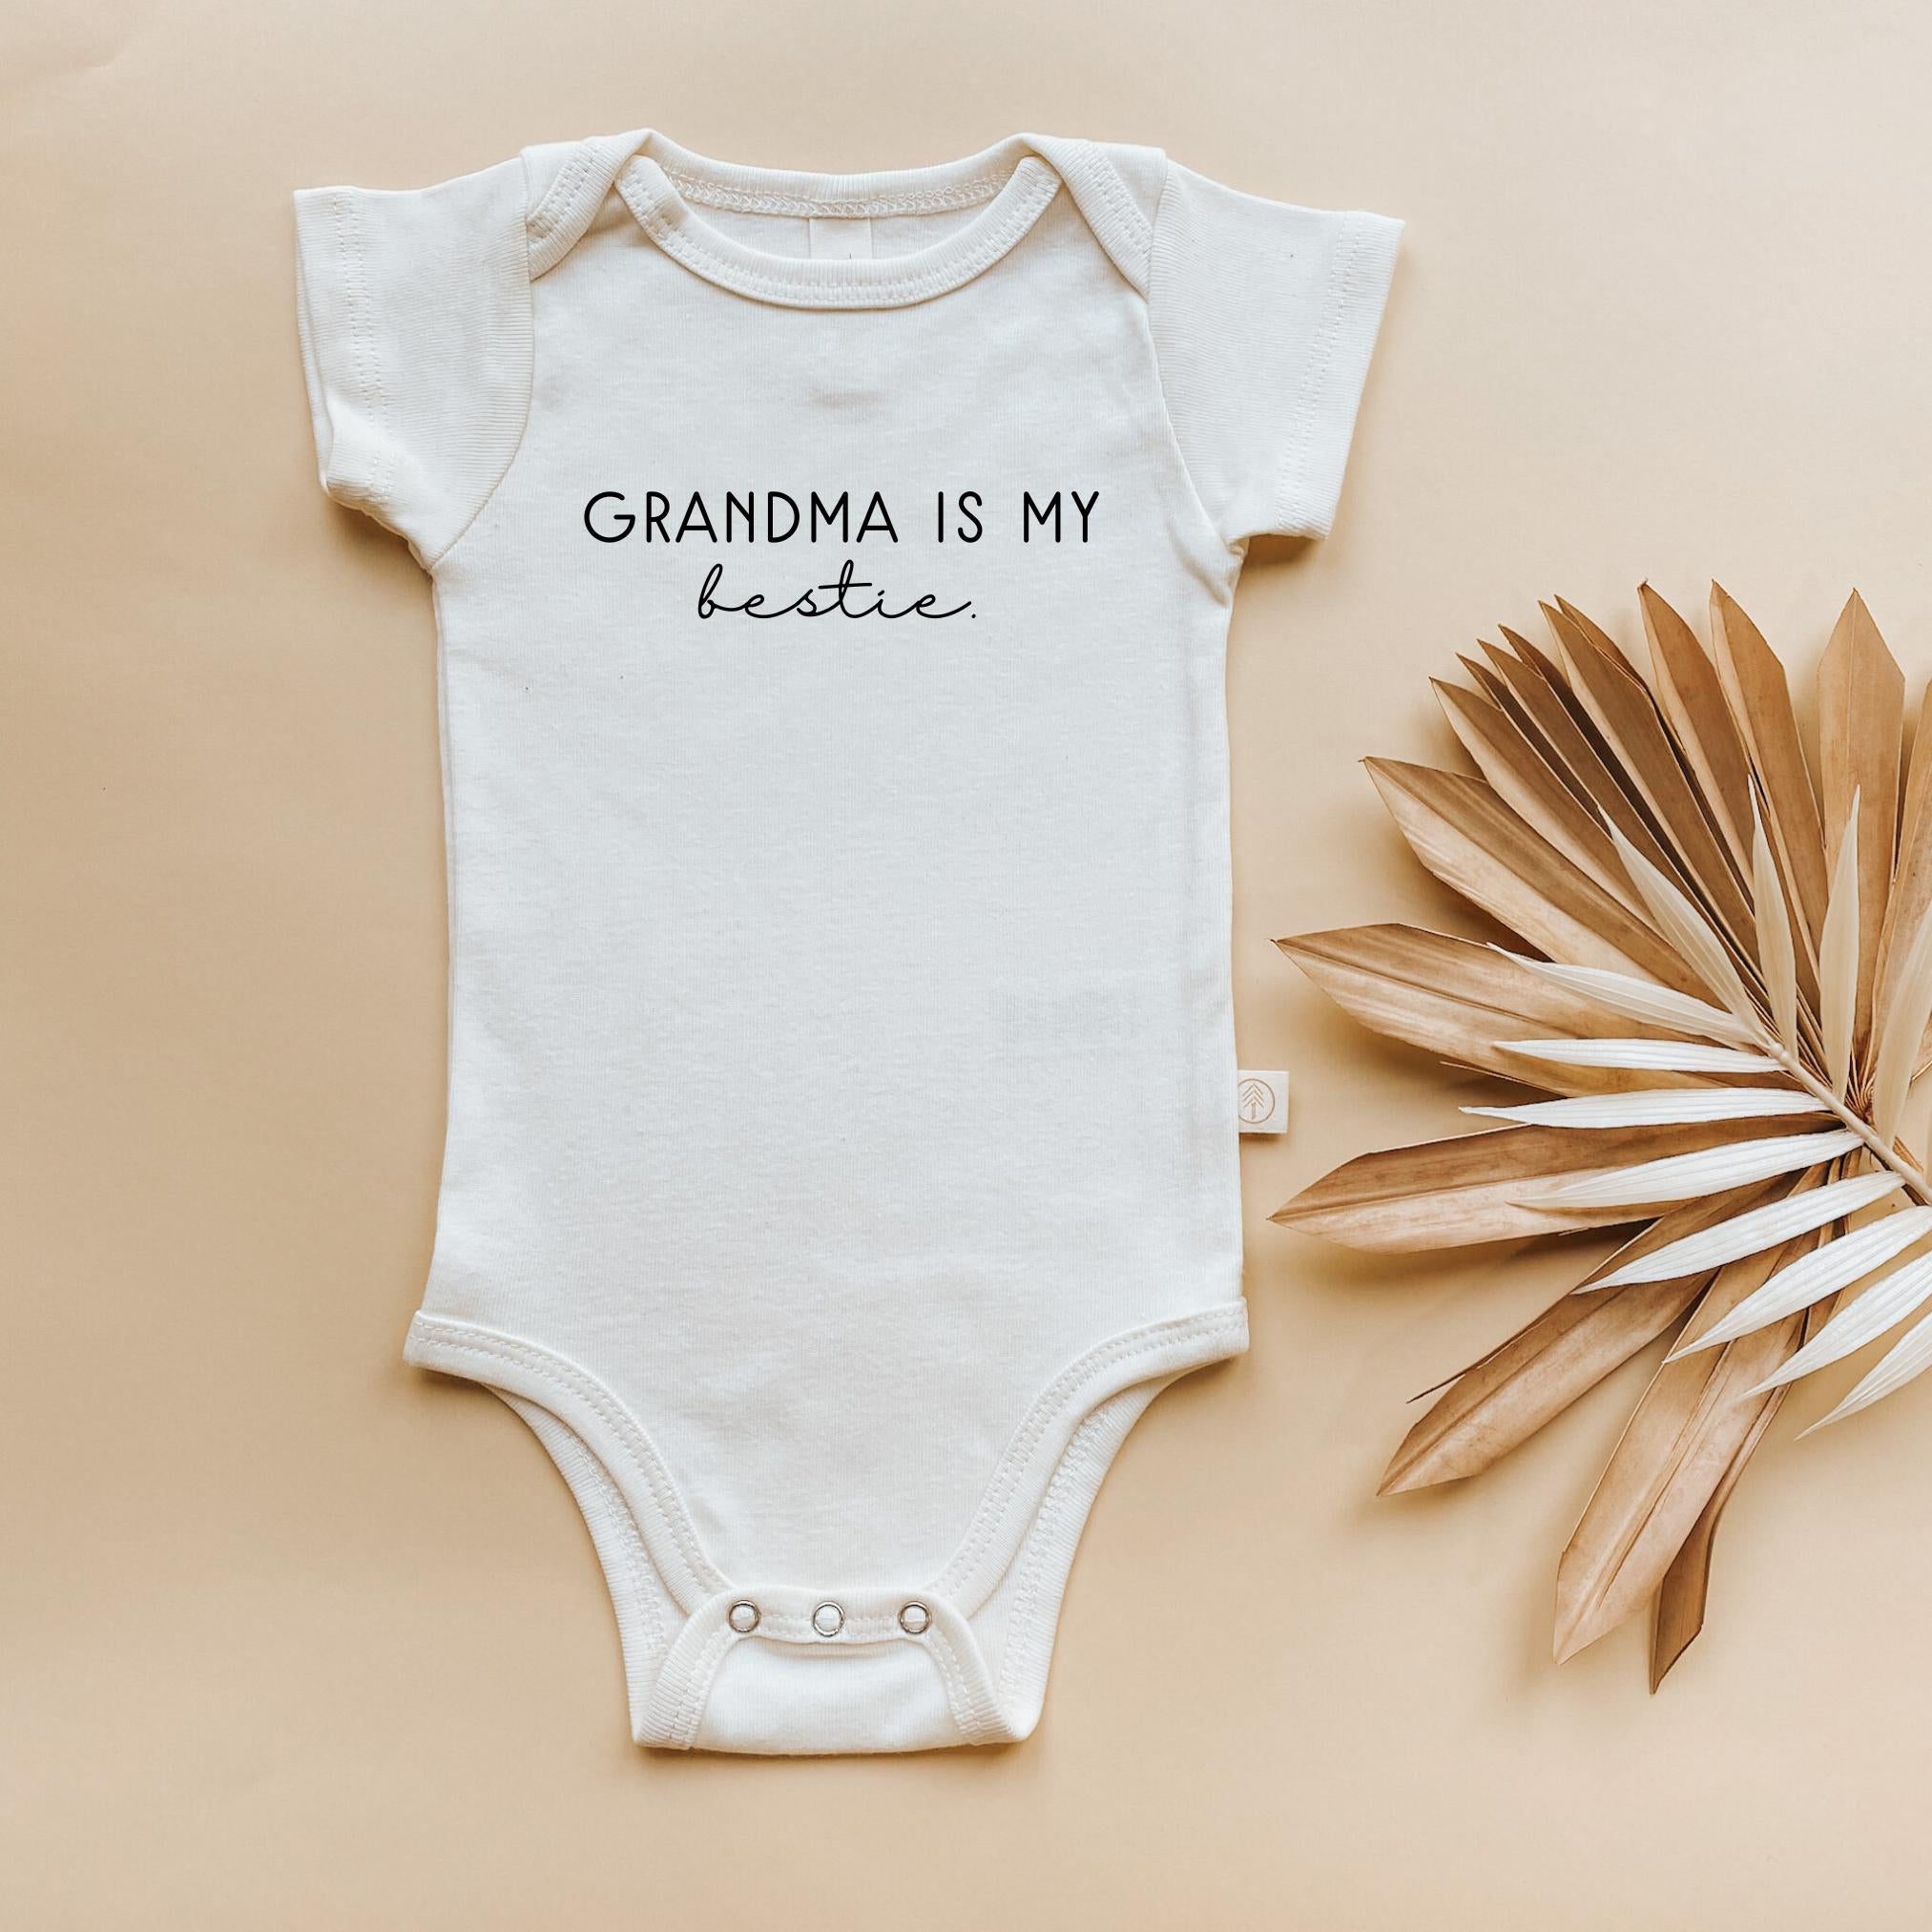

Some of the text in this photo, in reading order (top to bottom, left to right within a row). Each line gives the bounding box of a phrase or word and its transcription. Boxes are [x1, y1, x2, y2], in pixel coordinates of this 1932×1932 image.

[584, 491, 1099, 543] GRANDMA IS MY
[698, 560, 976, 619] bestie.
